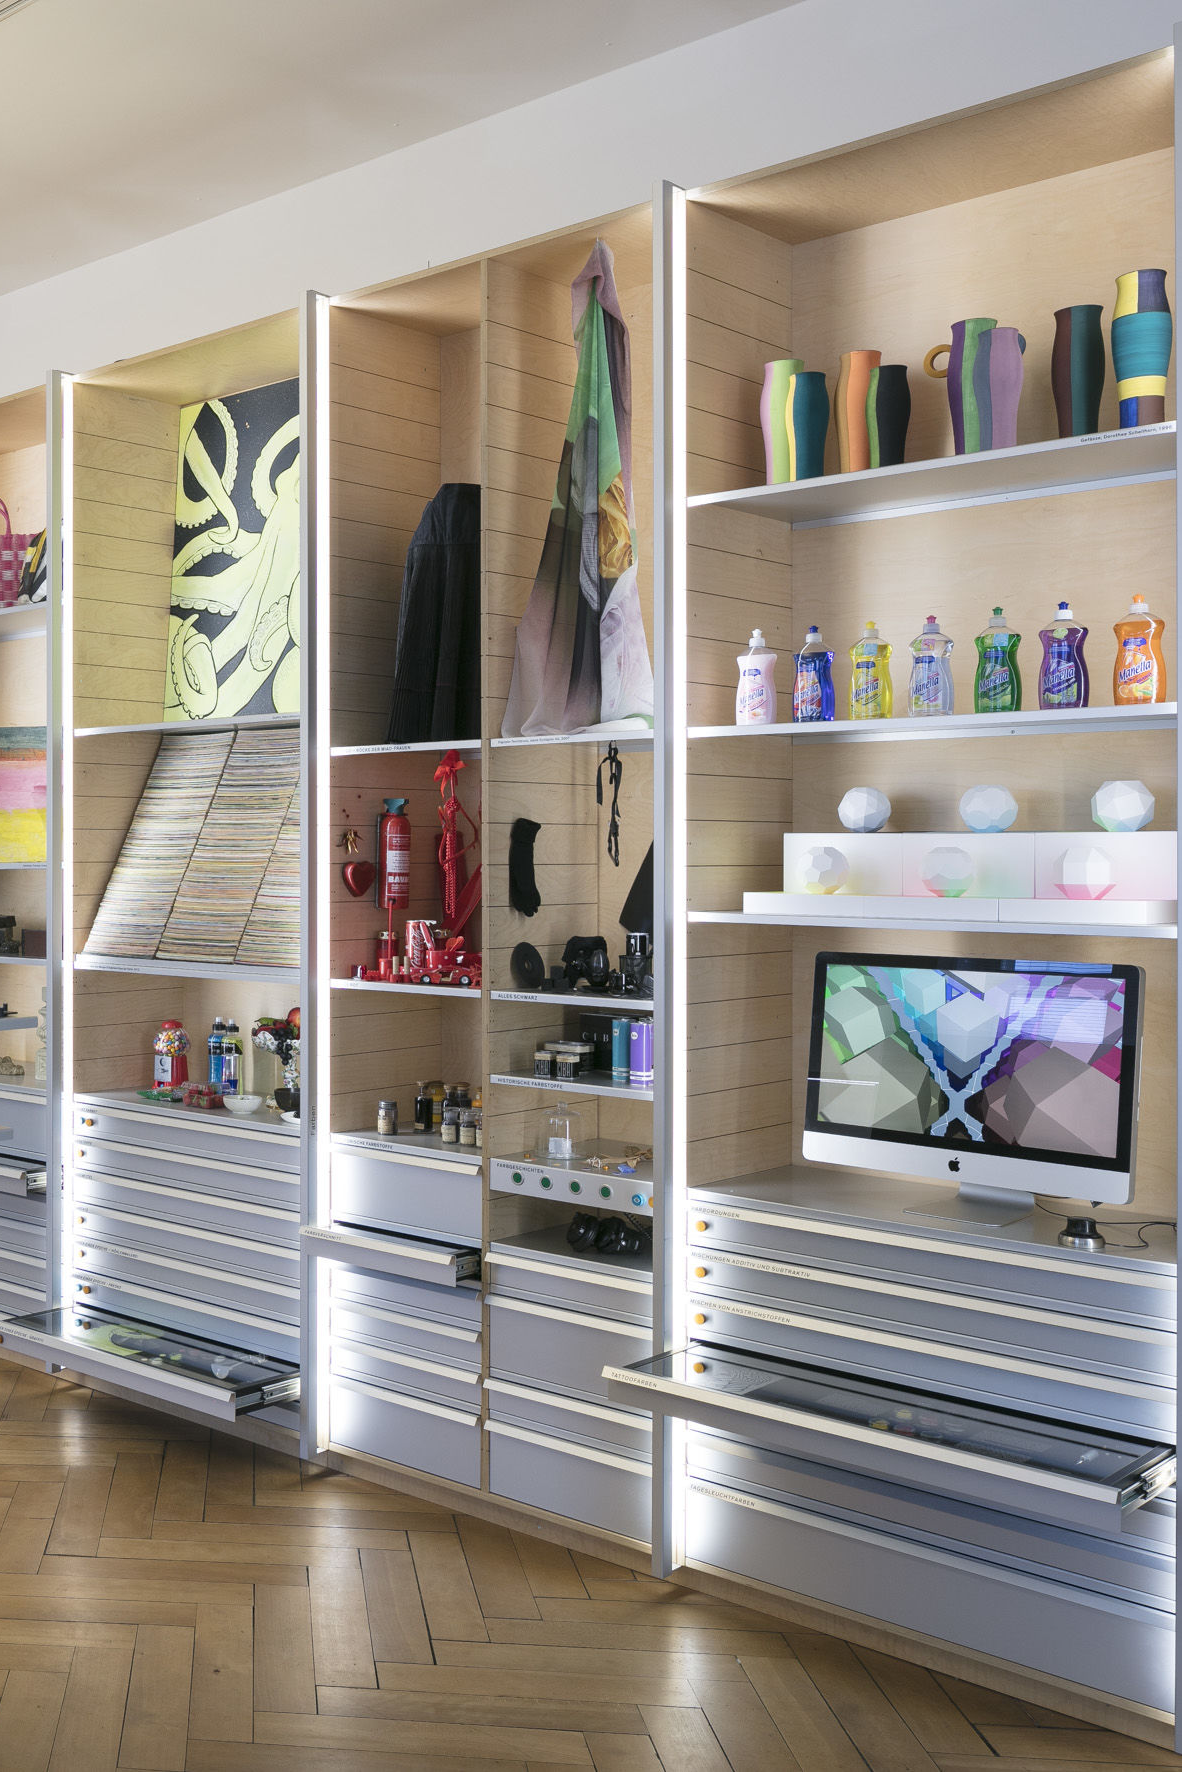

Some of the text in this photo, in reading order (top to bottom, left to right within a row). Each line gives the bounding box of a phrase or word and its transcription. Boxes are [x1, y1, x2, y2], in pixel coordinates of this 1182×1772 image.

[1043, 667, 1076, 688] Manella
[1119, 660, 1151, 680] Manella
[979, 671, 1009, 692] Manella
[582, 1031, 609, 1042] CIB
[497, 1078, 563, 1089] HISTORISCHE FARBSTOFFE
[496, 1162, 544, 1174] FARBGESCHICHTEN
[691, 1251, 811, 1278] MISCHUNGEN ADDITIV UND SUBTRAKTIV
[690, 1298, 717, 1308] MISCHEN
[732, 1306, 791, 1324] ANSTRICHSTOFFEN
[611, 1371, 657, 1388] TATTOOFARBEN
[690, 1484, 755, 1507] TAGESLEUCHTFARBEN
